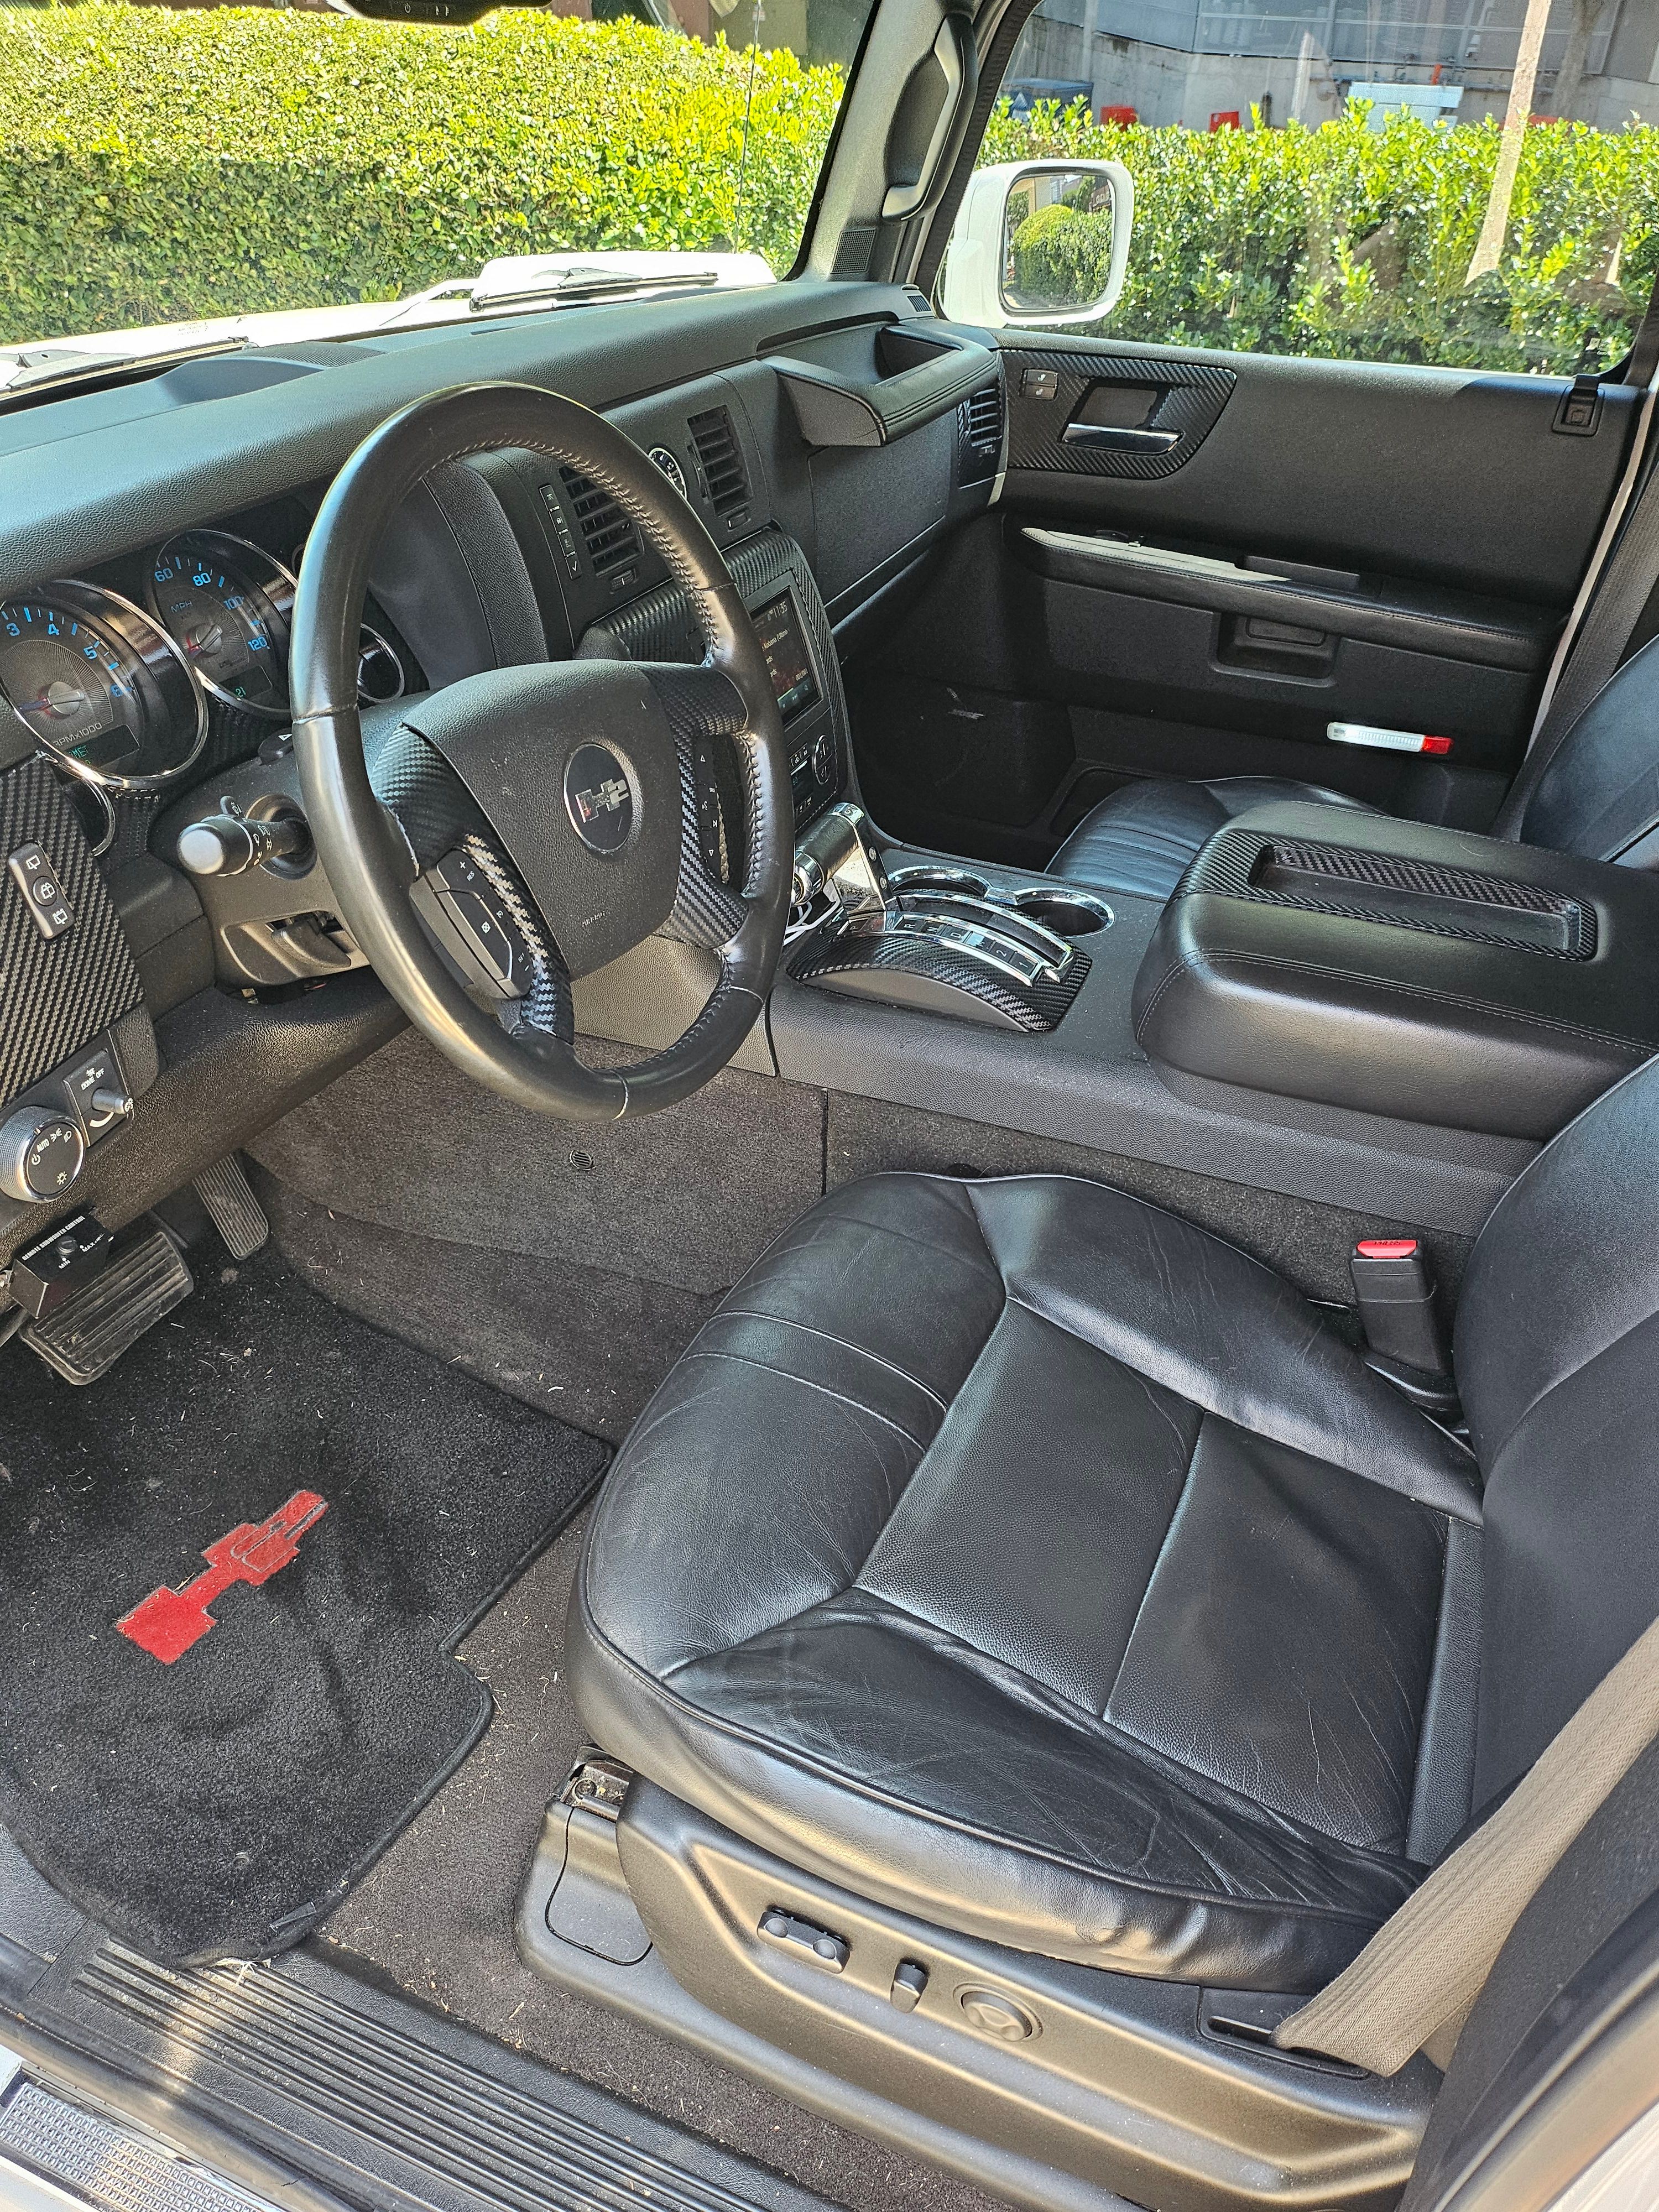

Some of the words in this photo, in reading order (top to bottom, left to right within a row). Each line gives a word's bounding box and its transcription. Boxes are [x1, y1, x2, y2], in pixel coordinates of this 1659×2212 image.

[155, 568, 173, 582] 60
[192, 572, 211, 587] 80
[171, 599, 193, 613] MPH
[223, 596, 242, 610] 100
[6, 623, 20, 637] 3
[48, 623, 59, 636] 4
[248, 637, 268, 651] 120
[83, 645, 97, 659] 5
[111, 685, 123, 698] 6
[467, 870, 475, 881] RES
[996, 950, 1007, 958] 2
[80, 1076, 95, 1091] DOME
[96, 1068, 105, 1079] OFF
[36, 1138, 50, 1152] AUTO
[22, 1245, 41, 1261] REMOTE
[39, 1228, 67, 1249] SUBWOOFER
[65, 1215, 86, 1230] CONTROL
[82, 1242, 95, 1253] MAX
[58, 1259, 71, 1269] MIN
